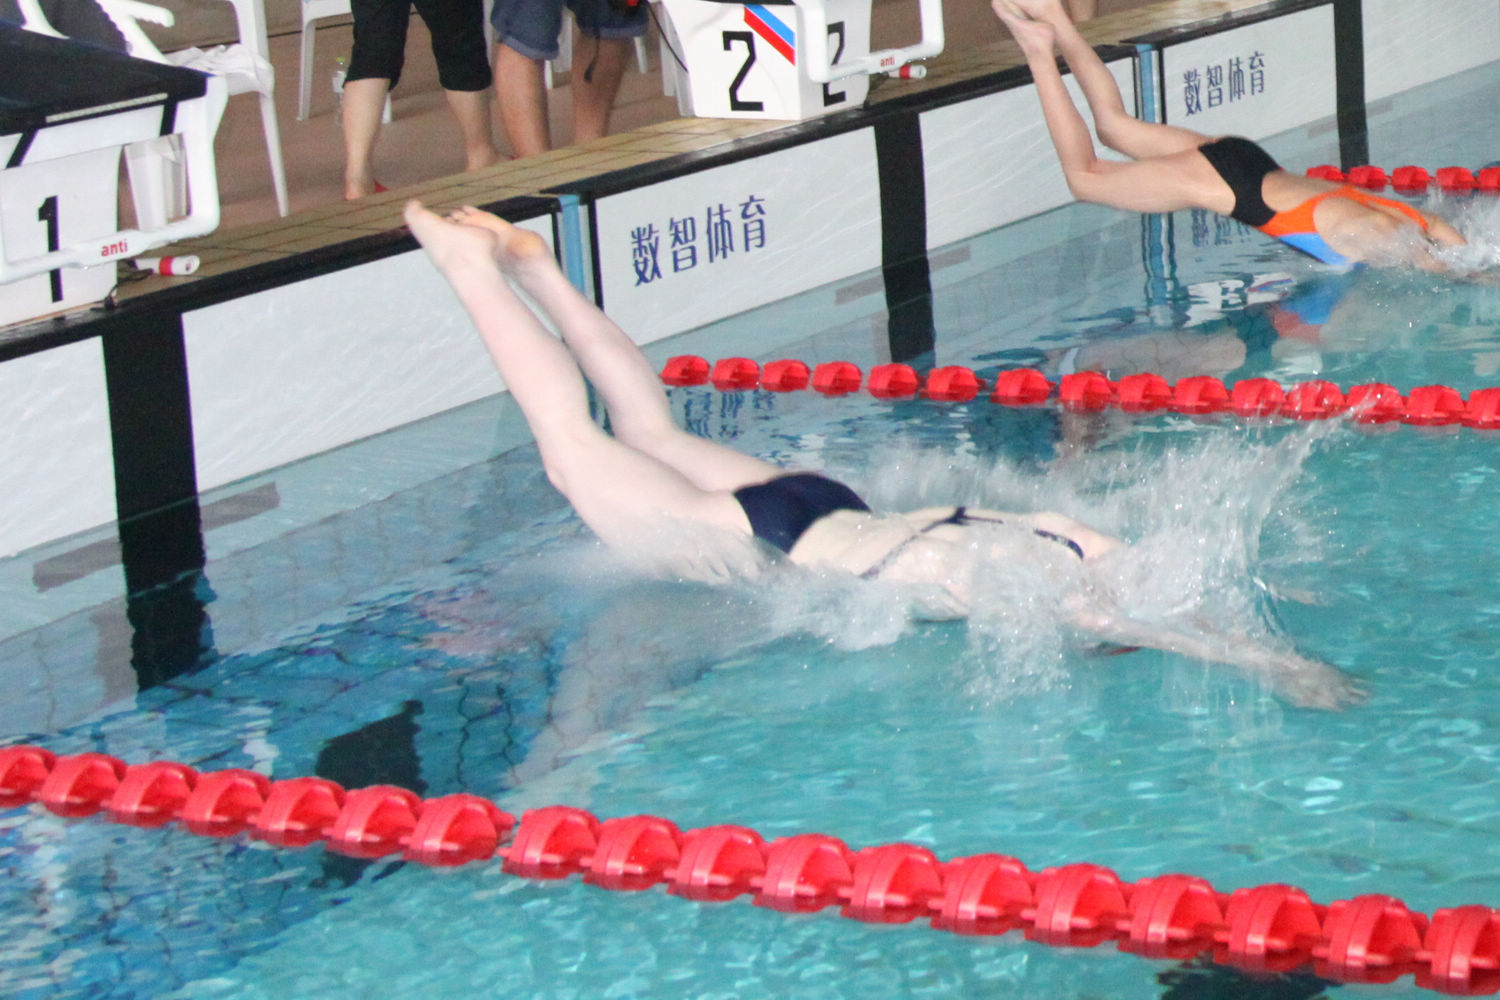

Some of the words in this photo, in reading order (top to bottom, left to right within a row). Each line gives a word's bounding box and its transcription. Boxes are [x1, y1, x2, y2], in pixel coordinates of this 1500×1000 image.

[722, 31, 763, 111] 2
[880, 56, 895, 67] anti
[1183, 51, 1265, 117] 数智体育
[38, 195, 63, 304] 1
[101, 239, 128, 257] anti
[630, 194, 767, 287] 数智体育
